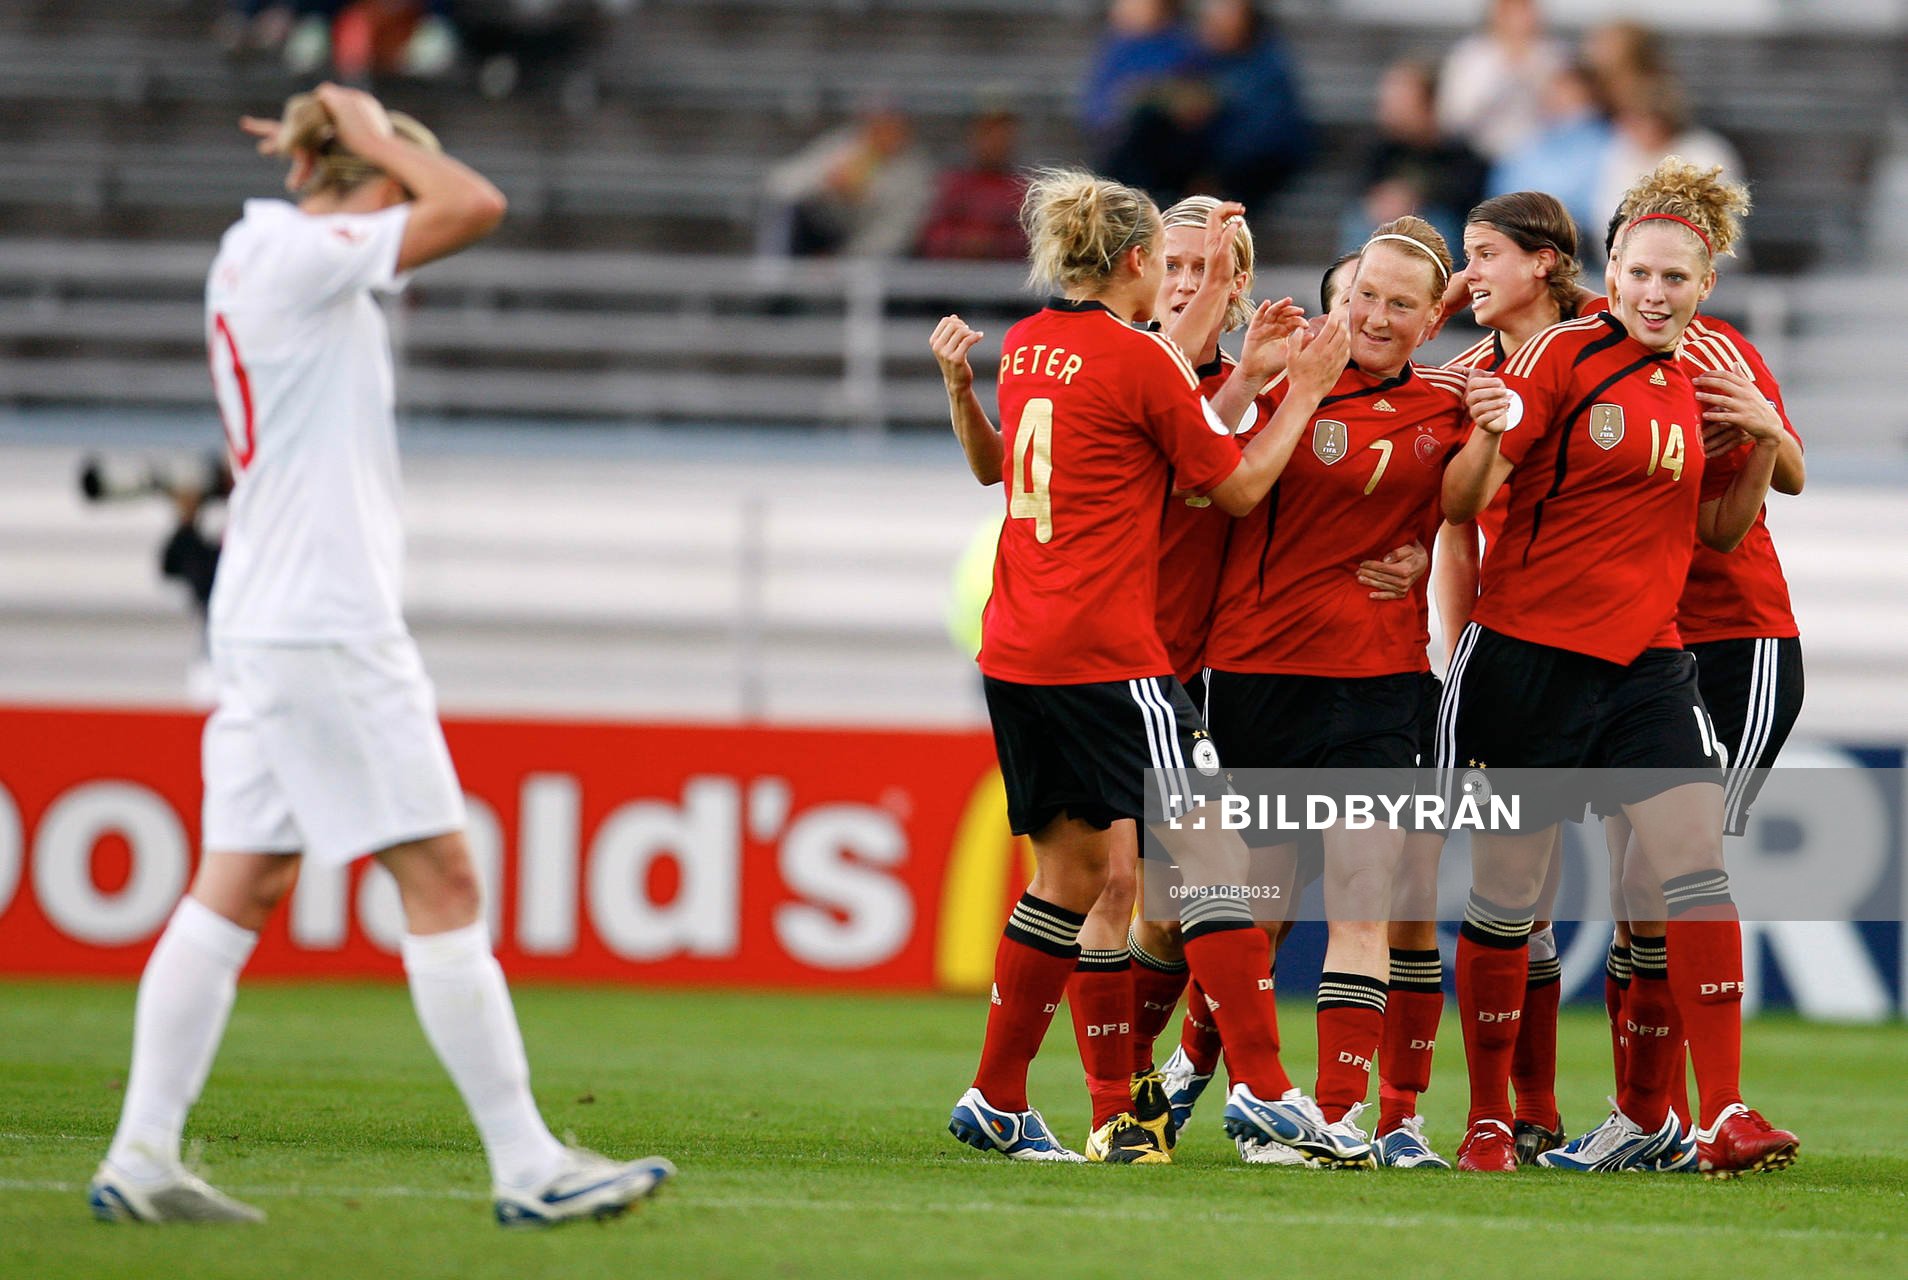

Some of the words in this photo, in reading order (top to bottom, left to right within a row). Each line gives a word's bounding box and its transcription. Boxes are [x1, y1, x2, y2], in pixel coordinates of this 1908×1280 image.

[999, 344, 1083, 385] PETER
[1647, 418, 1685, 481] 14
[1009, 398, 1053, 544] 4
[1364, 439, 1393, 495] 7
[1479, 1009, 1521, 1023] DFB
[1087, 1022, 1129, 1037] DFB
[1627, 1019, 1669, 1037] DFB
[1410, 1039, 1435, 1050] DF
[1338, 1051, 1372, 1073] DFB
